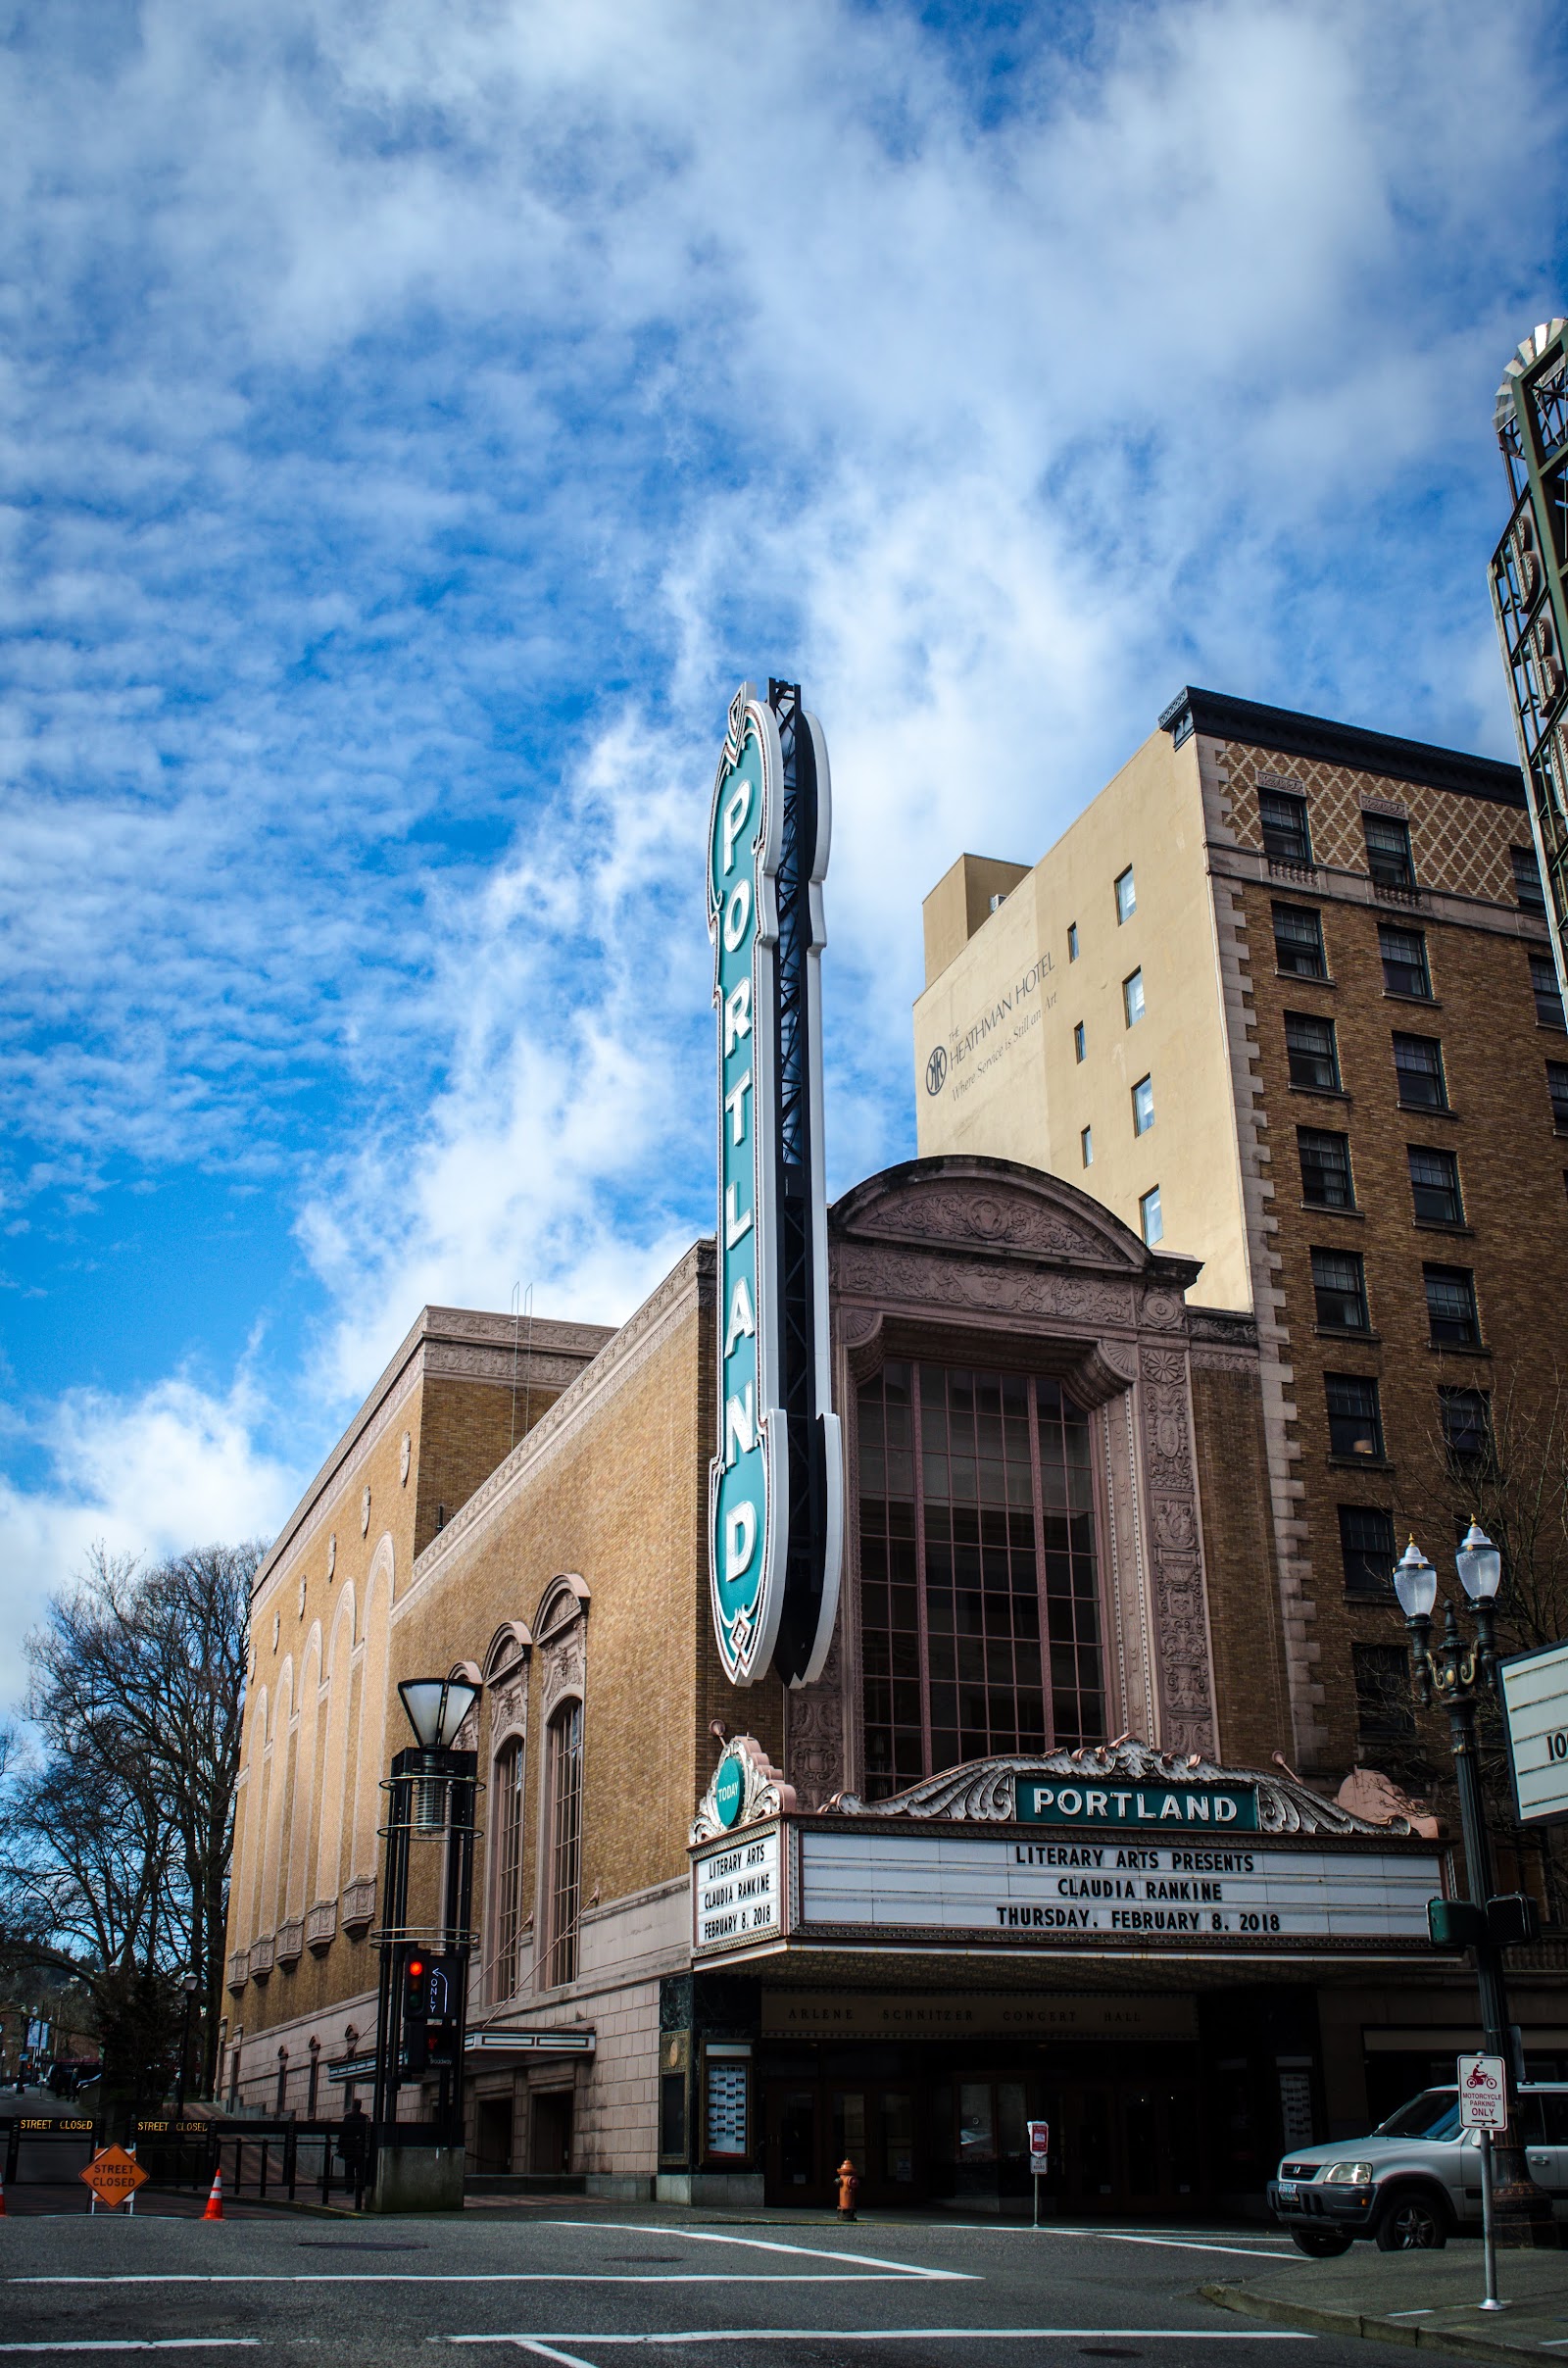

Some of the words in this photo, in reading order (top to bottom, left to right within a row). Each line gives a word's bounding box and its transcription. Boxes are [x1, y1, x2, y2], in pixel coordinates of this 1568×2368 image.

[951, 992, 1011, 1071] HEATHMAN
[1016, 952, 1055, 1004] HOTEL
[949, 1024, 959, 1044] THE
[953, 1073, 976, 1102] Where
[977, 1046, 1004, 1077] Service
[1004, 1038, 1011, 1051] is
[1013, 1014, 1028, 1043] Still
[1031, 1009, 1041, 1025] an
[1044, 991, 1056, 1013] Art
[723, 779, 757, 1582] PORTLAND
[1546, 1732, 1568, 1761] 10
[718, 1780, 739, 1802] TODAY
[1033, 1788, 1238, 1822] PORTLAND
[709, 1850, 742, 1879] LITERARY
[746, 1844, 764, 1865] ARTS
[1016, 1847, 1103, 1867] LITERARY
[1116, 1850, 1158, 1868] ARTS
[1172, 1852, 1253, 1872] PRESENTS
[705, 1884, 733, 1909] CLAUDIA
[738, 1874, 769, 1899] RANKINE
[1057, 1878, 1135, 1899] CLAUDIA
[1147, 1881, 1222, 1900] RANKINE
[705, 1913, 737, 1941] FEBRUARY
[754, 1904, 771, 1927] 2018
[1112, 1910, 1200, 1931] FEBRUARY
[1240, 1913, 1280, 1931] 2018
[788, 2009, 855, 2020] ARLENE
[882, 2009, 973, 2021] SCHNITZER
[1003, 2010, 1076, 2022] CONCERT
[1103, 2011, 1142, 2022] HALL
[1472, 2107, 1494, 2116] ONLY
[21, 2119, 53, 2130] STREET
[60, 2119, 93, 2130] CLOSED
[137, 2121, 170, 2132] STREET
[94, 2164, 134, 2174] STREET
[92, 2177, 135, 2188] CLOSED
